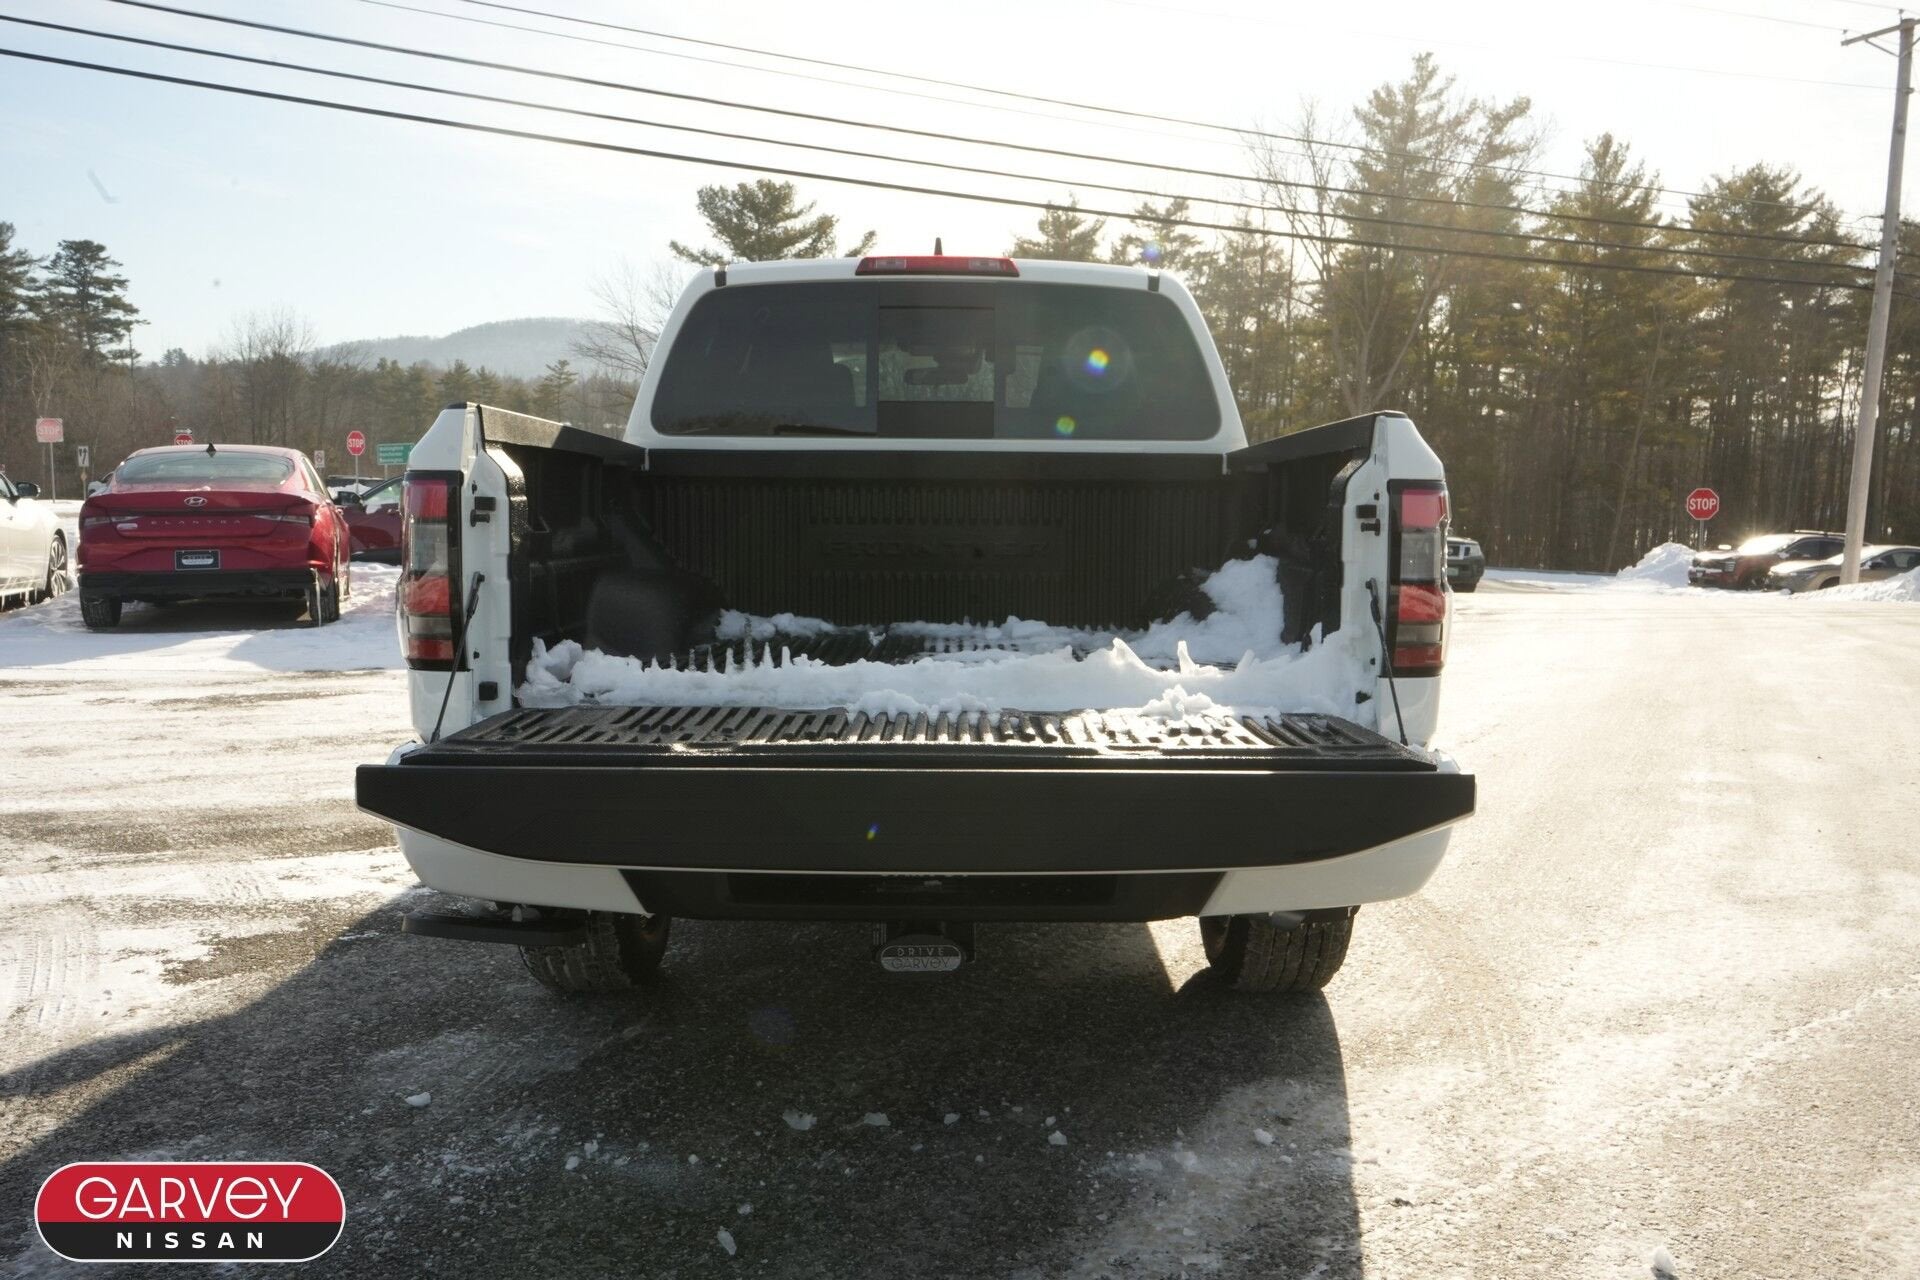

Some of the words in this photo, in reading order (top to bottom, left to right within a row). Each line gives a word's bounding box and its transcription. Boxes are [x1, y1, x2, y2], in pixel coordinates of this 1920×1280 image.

[348, 438, 364, 448] STOP
[1689, 498, 1716, 510] STOP
[897, 947, 944, 956] DRIVE
